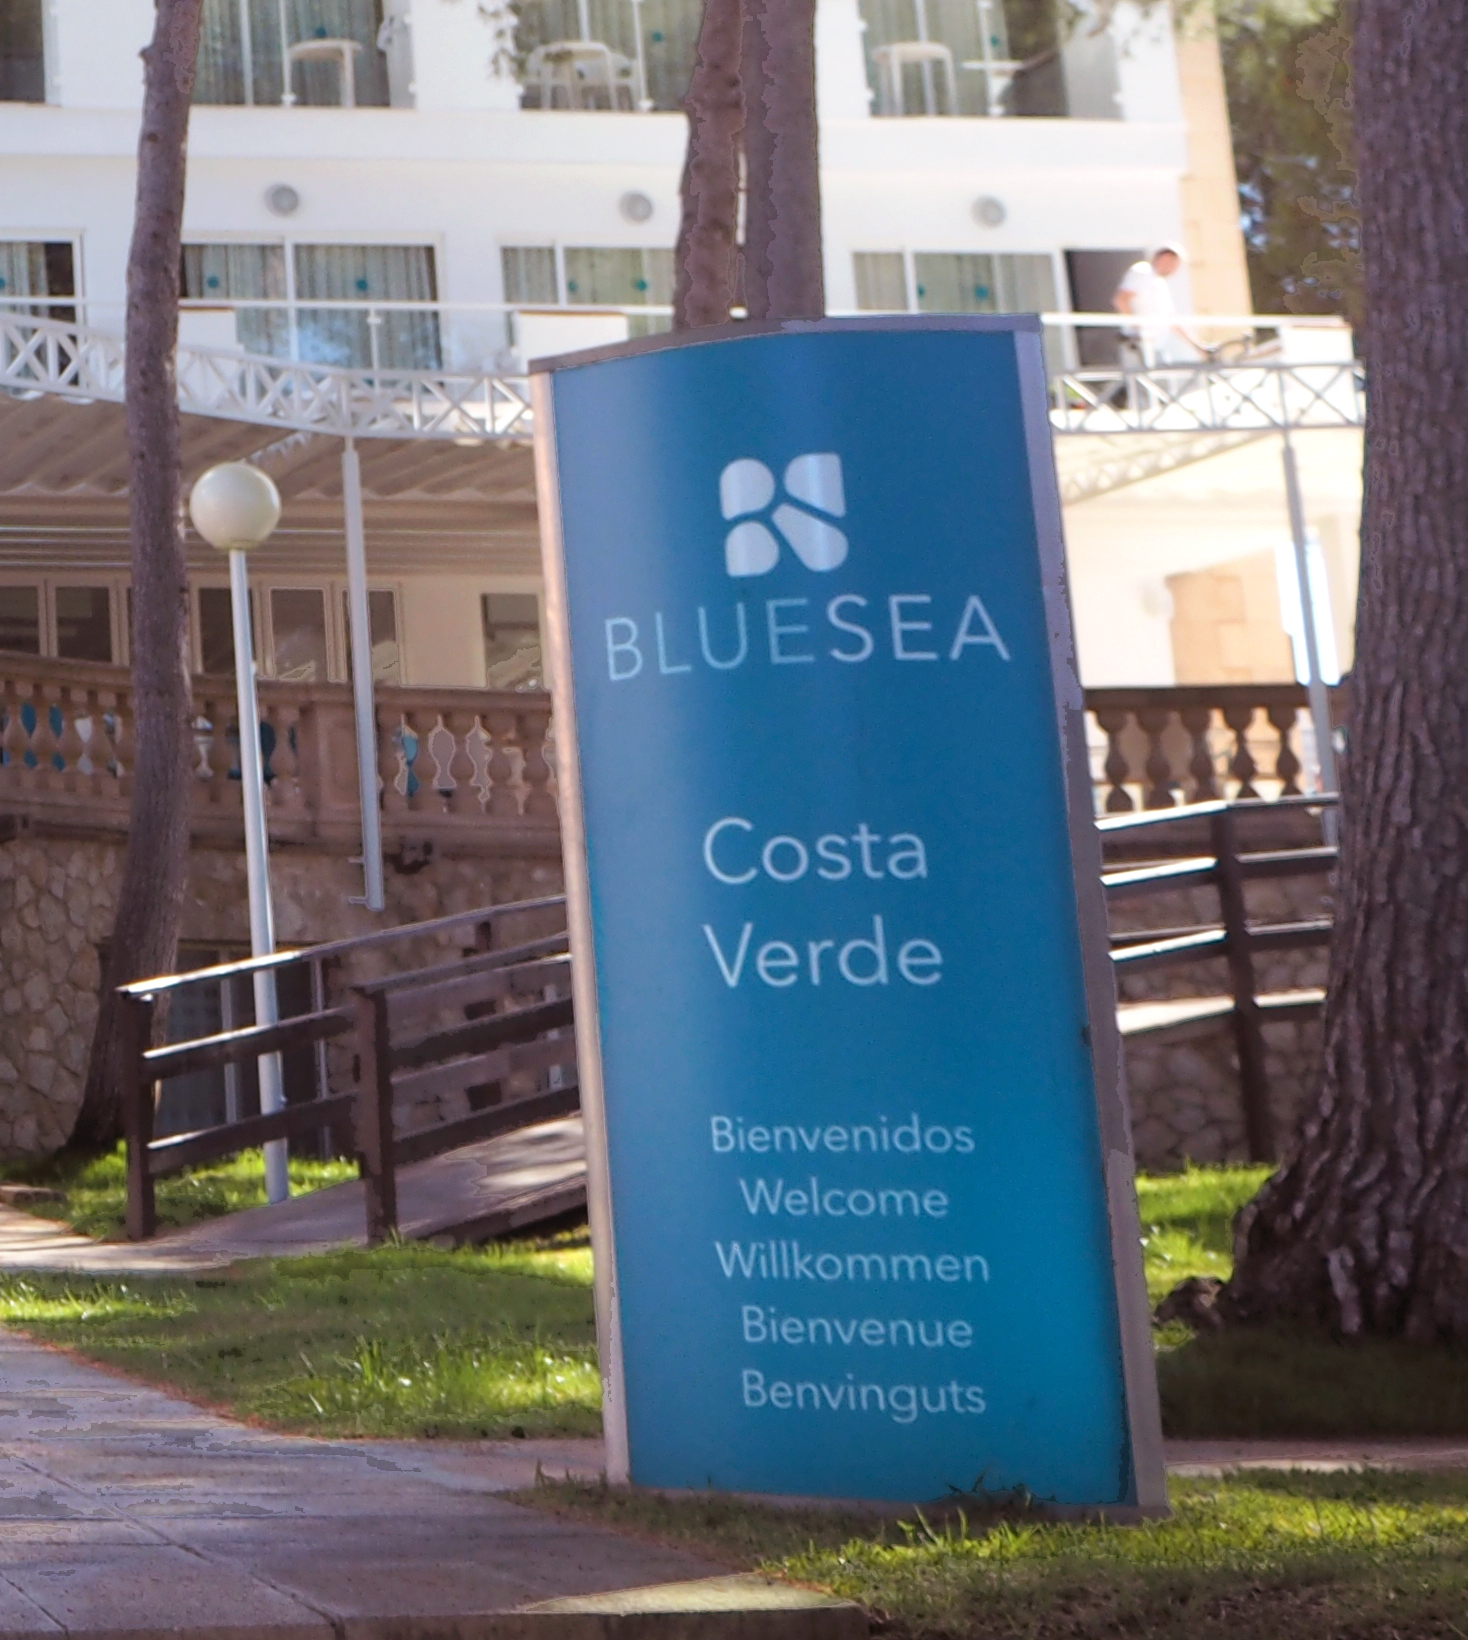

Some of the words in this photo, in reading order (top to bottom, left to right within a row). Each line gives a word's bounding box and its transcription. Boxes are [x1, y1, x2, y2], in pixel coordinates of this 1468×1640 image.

[604, 594, 1011, 681] BLUESEA
[703, 816, 928, 885] Costa
[702, 914, 944, 989] Verde
[710, 1112, 976, 1153] Bienvenidos
[738, 1176, 950, 1218] Welcome
[715, 1239, 990, 1283] Willkommen
[742, 1304, 974, 1348] Bienvenue
[742, 1368, 987, 1424] Benvinguts
